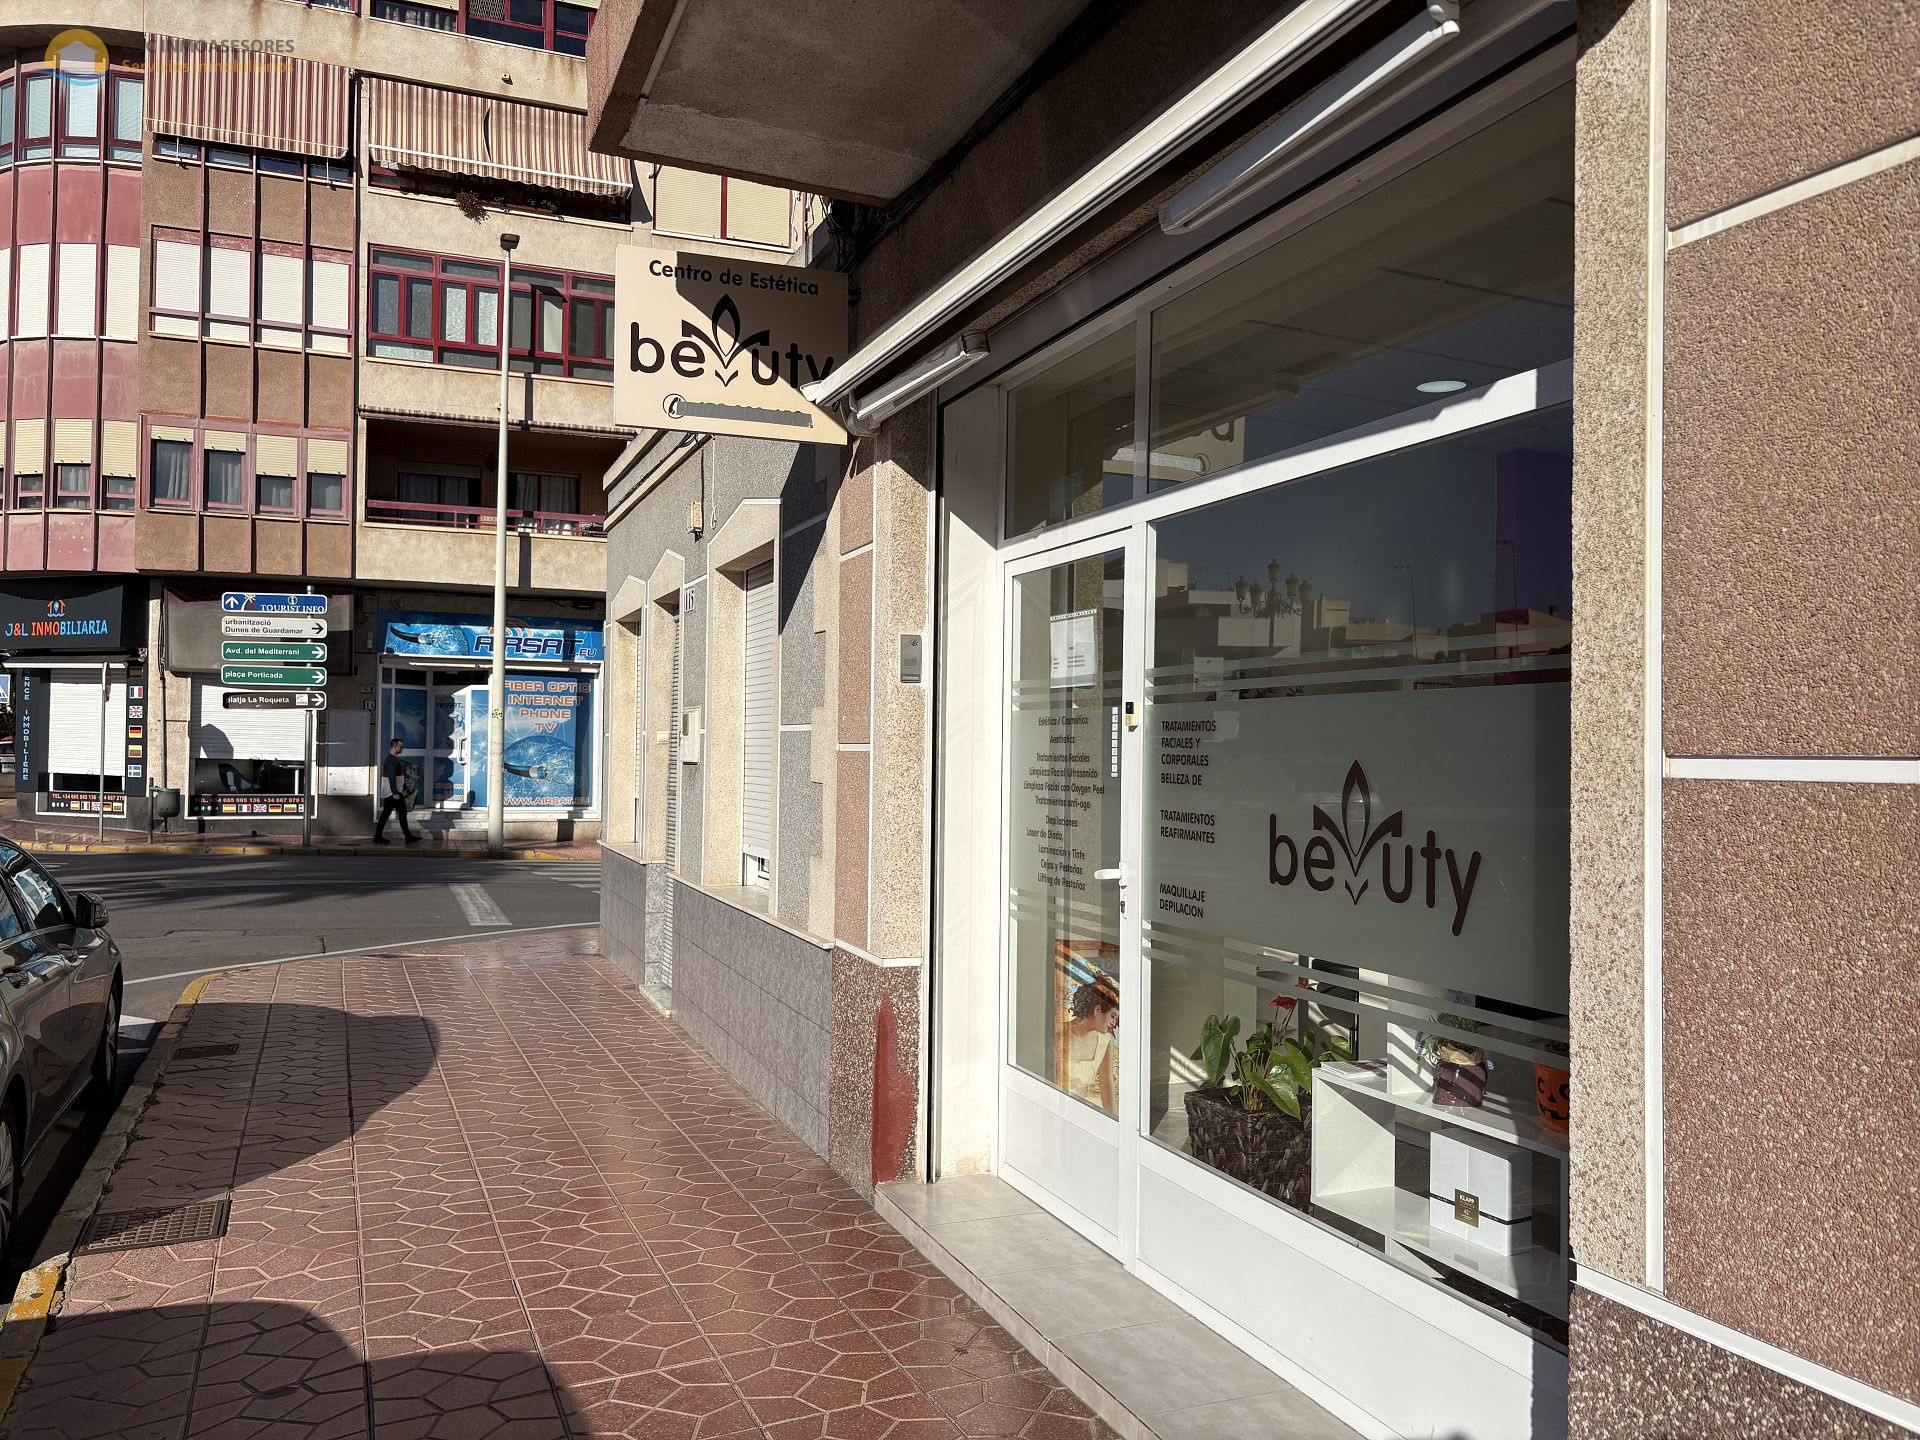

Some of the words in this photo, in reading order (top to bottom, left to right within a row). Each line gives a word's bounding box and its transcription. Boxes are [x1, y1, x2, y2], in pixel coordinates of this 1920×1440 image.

[649, 259, 713, 283] Centro
[719, 268, 743, 286] de
[750, 272, 819, 296] Estética
[260, 604, 300, 612] TOURIST
[302, 605, 325, 613] INFO
[5, 623, 28, 637] J&L
[31, 620, 108, 636] INMOBILIARIA
[262, 627, 304, 635] Guardamar
[244, 647, 257, 655] del
[225, 671, 246, 679] plaça
[247, 671, 283, 679] Porticada
[504, 680, 545, 693] FIBER
[547, 682, 592, 694] OPTIC
[259, 697, 290, 705] Roqueta
[508, 694, 583, 707] INTERNET
[519, 707, 572, 720] PHONE
[535, 722, 557, 733] TV
[1161, 720, 1216, 732] TRATAMIENTOS
[1161, 737, 1193, 749] FACIALES
[1195, 738, 1201, 749] Y
[1036, 752, 1068, 763] Tratamientos
[1068, 753, 1090, 763] Faciales
[1161, 753, 1209, 767] CORPORALES
[1161, 772, 1190, 785] BELLEZA
[1191, 774, 1202, 786] DE
[1023, 780, 1044, 791] Limpieza
[1044, 781, 1060, 792] Facial
[1060, 784, 1070, 792] con
[1071, 783, 1092, 796] Oxygen
[1092, 784, 1105, 795] Peel
[1034, 795, 1067, 807] Tratamientos
[1045, 815, 1078, 828] Depilaciones
[1160, 809, 1215, 826] TRATAMIENTOS
[1039, 828, 1047, 838] de
[1160, 826, 1215, 844] REAFIRMANTES
[1071, 849, 1086, 860] Tinte
[1040, 859, 1054, 870] Cejas
[1059, 862, 1083, 875] Pestañas
[1053, 876, 1061, 886] de
[1061, 878, 1086, 891] Pestañas
[1160, 883, 1206, 902] MAQUILLAJE
[1160, 899, 1204, 918] DEPILACION
